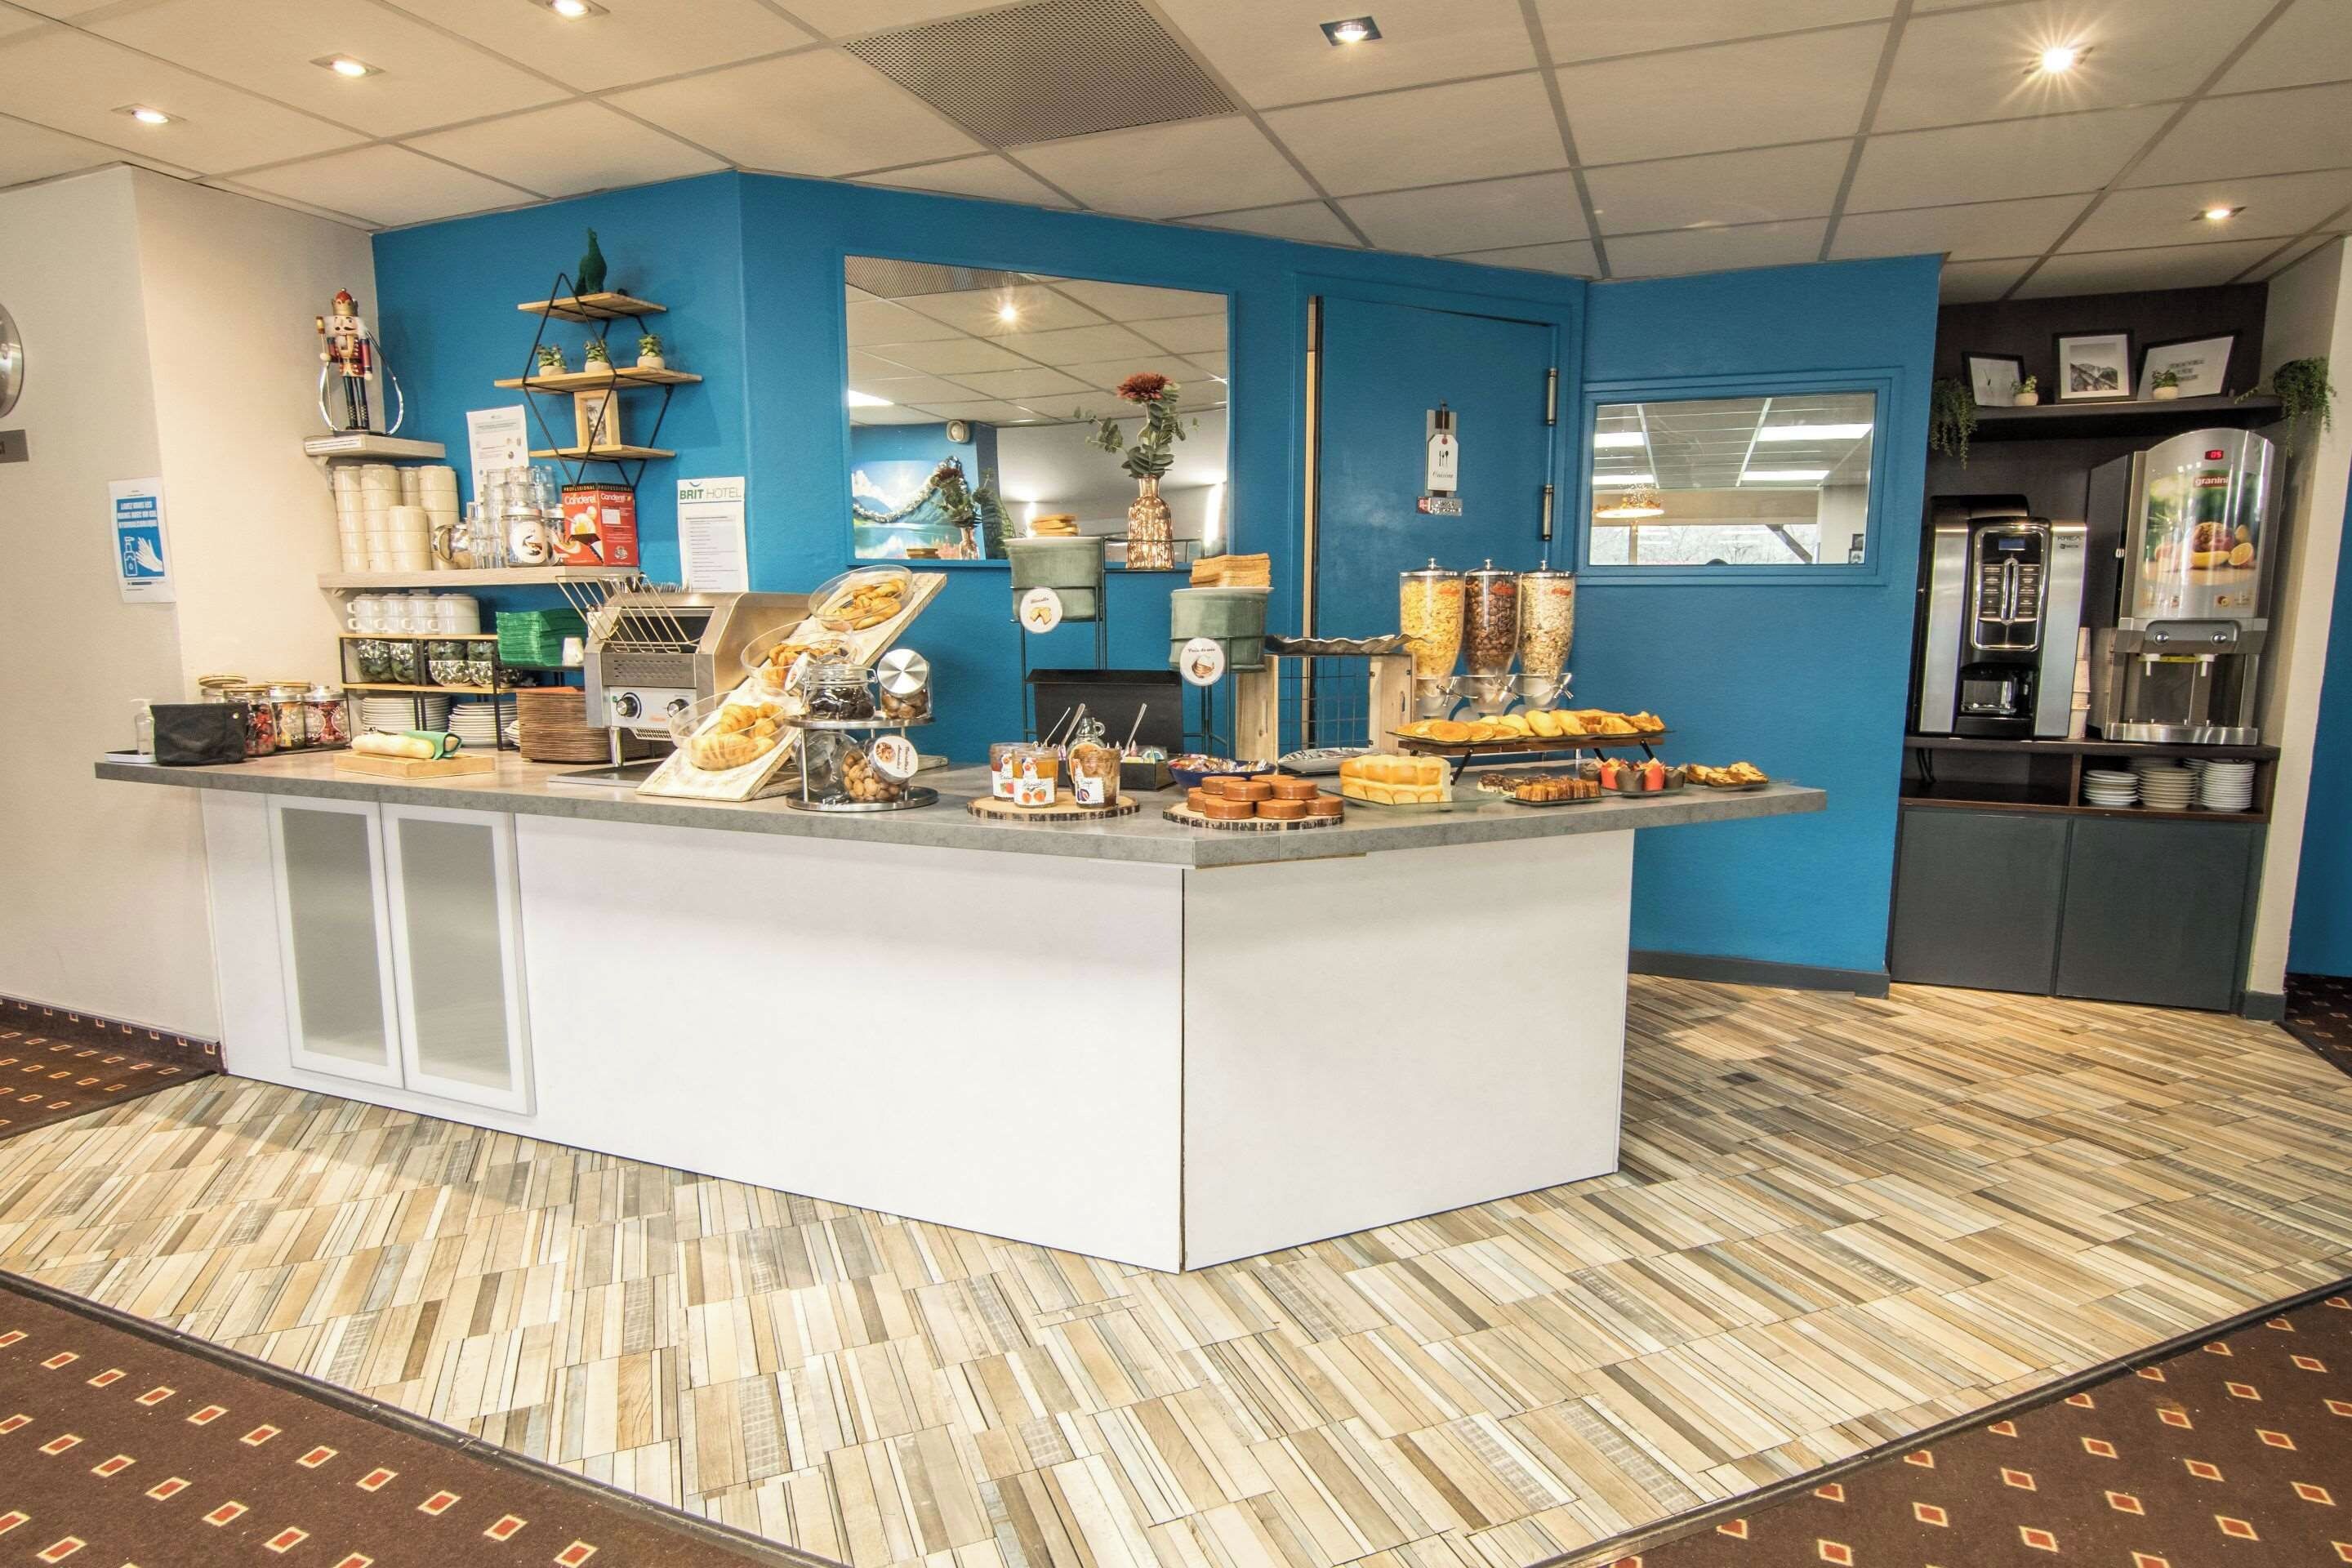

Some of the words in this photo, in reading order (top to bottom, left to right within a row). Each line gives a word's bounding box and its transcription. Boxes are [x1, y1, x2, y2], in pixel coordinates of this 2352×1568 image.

[2195, 477, 2230, 487] granini
[564, 494, 597, 506] Canderel
[679, 489, 704, 500] BRIT
[706, 488, 742, 499] HOTEL
